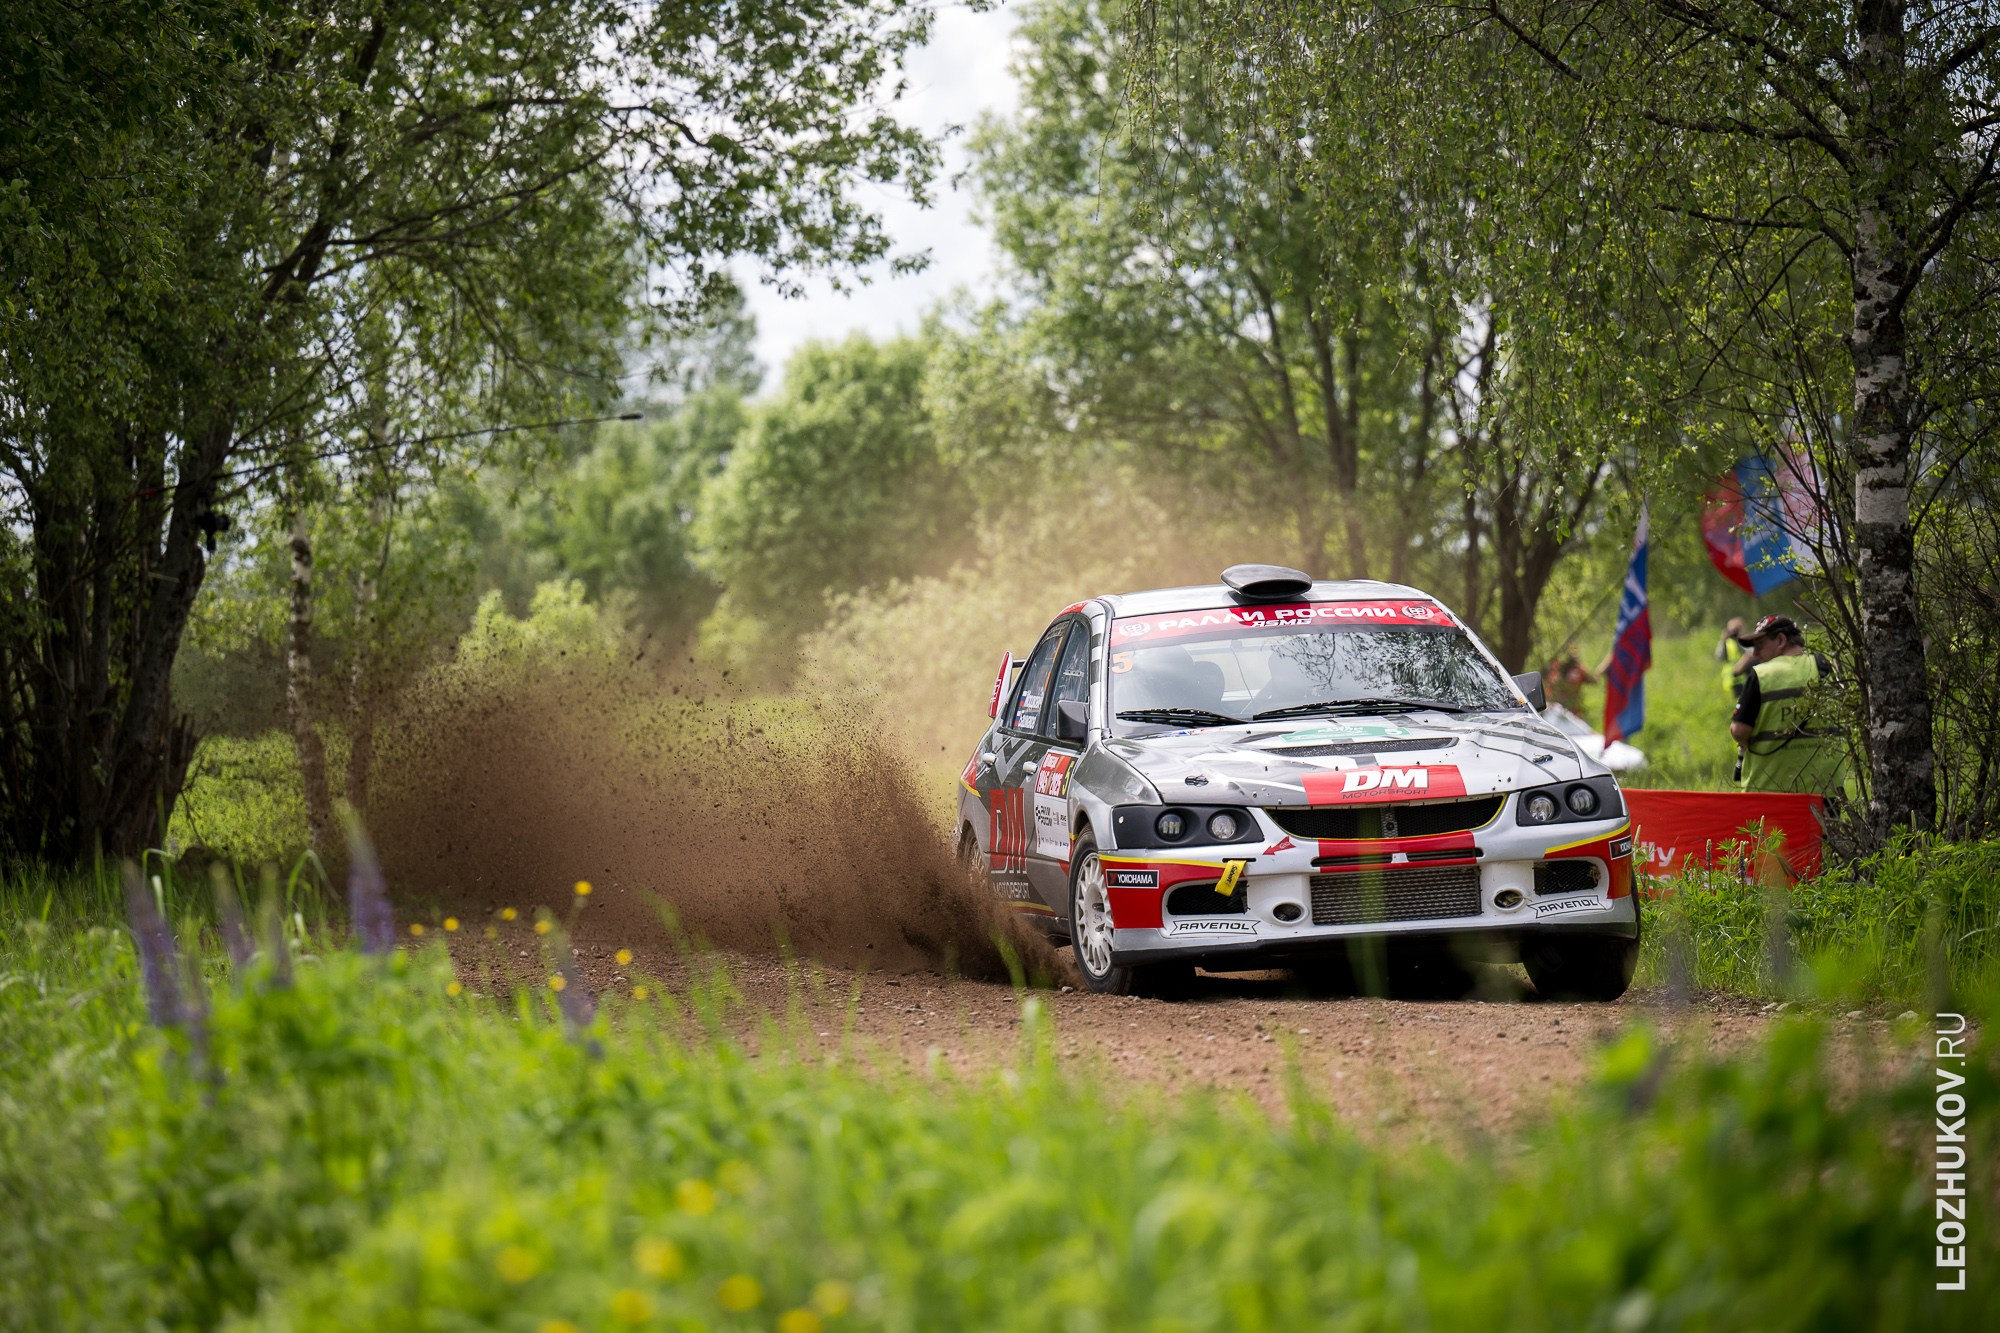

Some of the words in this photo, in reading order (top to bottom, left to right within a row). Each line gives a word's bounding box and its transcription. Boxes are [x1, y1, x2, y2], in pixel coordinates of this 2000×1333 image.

[1158, 610, 1265, 631] РАЛЛИ
[1275, 607, 1397, 620] РОССИИ
[1111, 652, 1134, 674] 5
[1384, 727, 1403, 736] 5
[1061, 760, 1076, 796] 5
[1340, 768, 1429, 793] DM
[1342, 789, 1428, 799] MOTORSPORT
[1117, 874, 1153, 884] YOKOHAMA
[1539, 898, 1598, 913] RAVENOL
[1179, 922, 1250, 931] RAVENOL
